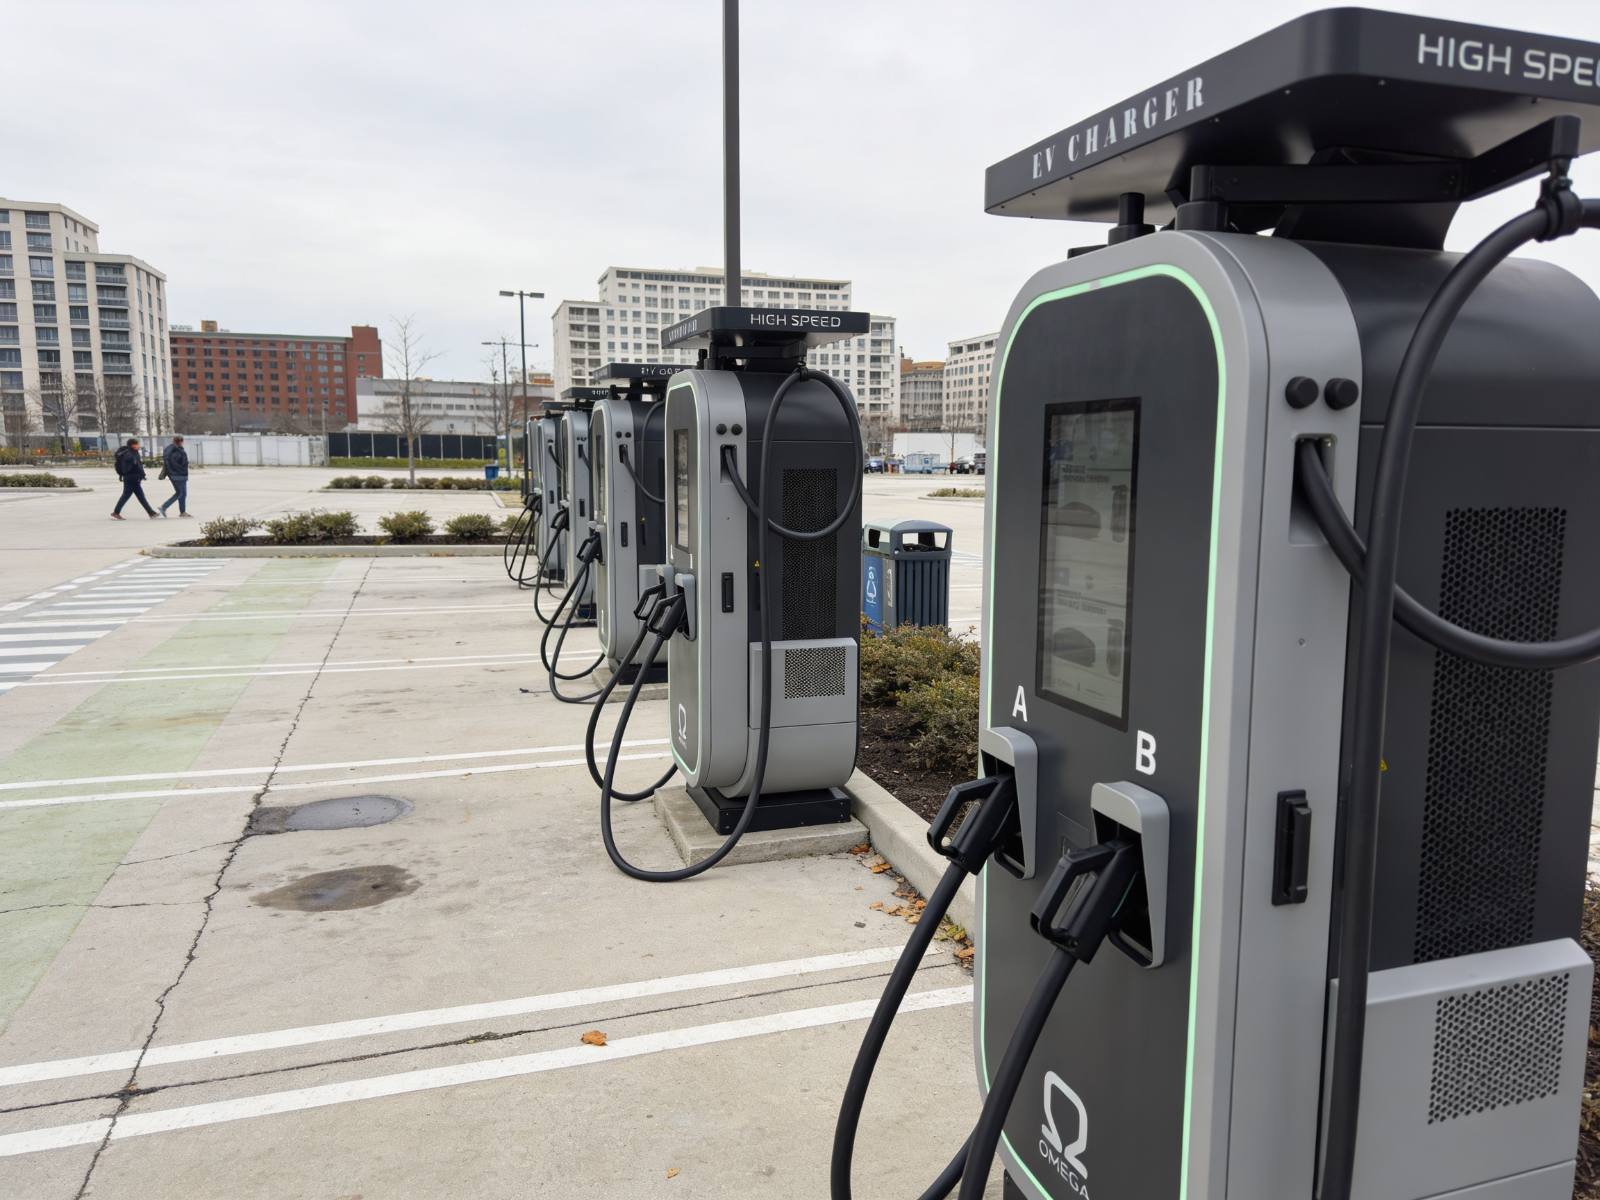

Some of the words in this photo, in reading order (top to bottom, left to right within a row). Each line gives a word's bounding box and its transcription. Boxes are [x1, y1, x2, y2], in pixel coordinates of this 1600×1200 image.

[1418, 33, 1512, 76] HIGH
[1523, 49, 1600, 88] SPE
[1032, 145, 1056, 179] EV
[1067, 77, 1204, 162] CHARGER
[750, 313, 787, 326] HIGH
[791, 315, 841, 328] SPEED
[1012, 685, 1028, 722] A
[1136, 729, 1157, 776] B
[1039, 1139, 1090, 1200] OMEGA
